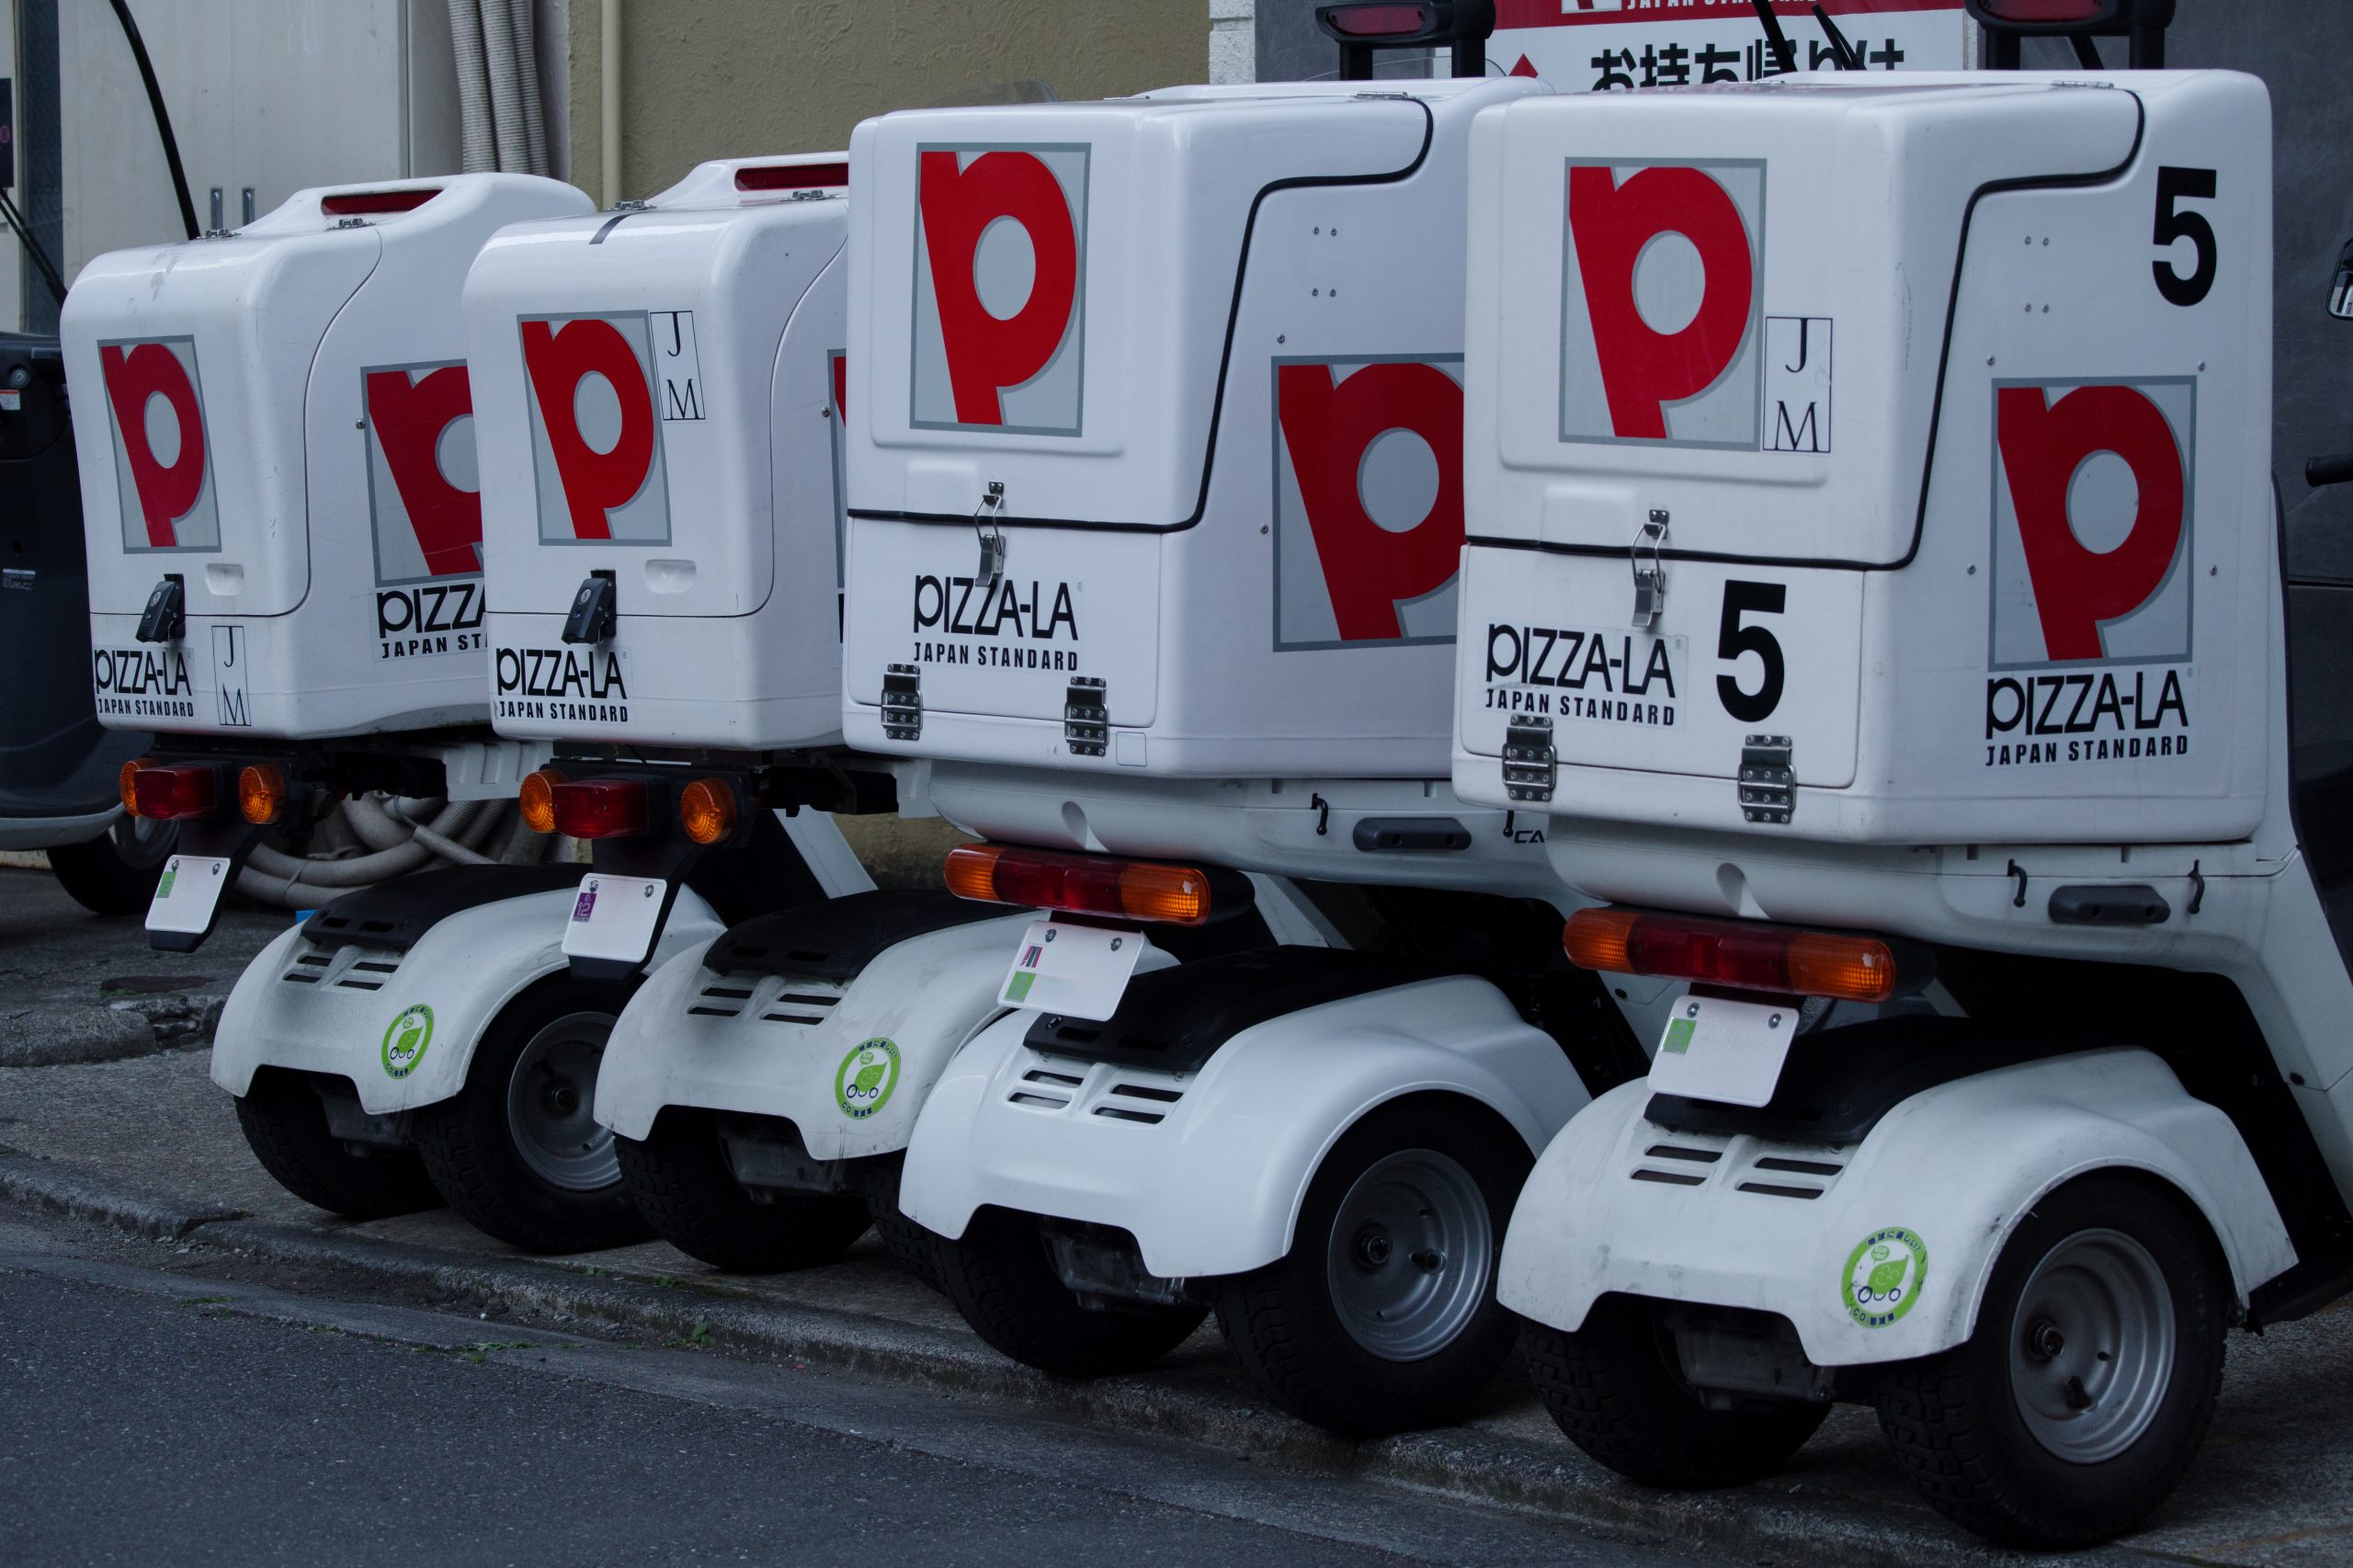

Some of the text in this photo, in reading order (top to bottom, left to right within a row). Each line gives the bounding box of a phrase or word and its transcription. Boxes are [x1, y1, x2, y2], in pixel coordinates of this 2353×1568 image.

[2153, 166, 2217, 306] 5
[376, 583, 485, 639] PIZZ
[914, 574, 1079, 641] PIZZA-LA
[381, 633, 487, 659] JAPAN ST
[914, 642, 1077, 671] JAPAN STANDARD
[1486, 623, 1676, 699] PIZZA-LA
[1716, 579, 1787, 722] 5
[95, 649, 192, 697] PIZZA-LA
[495, 647, 628, 700] PIZZA-LA
[98, 698, 194, 718] JAPAN STANDARD
[499, 700, 629, 722] JAPAN STANDARD
[1485, 688, 1675, 726] JAPAN STANDARD
[1985, 670, 2189, 740] PIZZA-LA
[1985, 734, 2188, 767] JAPAN STANDARD
